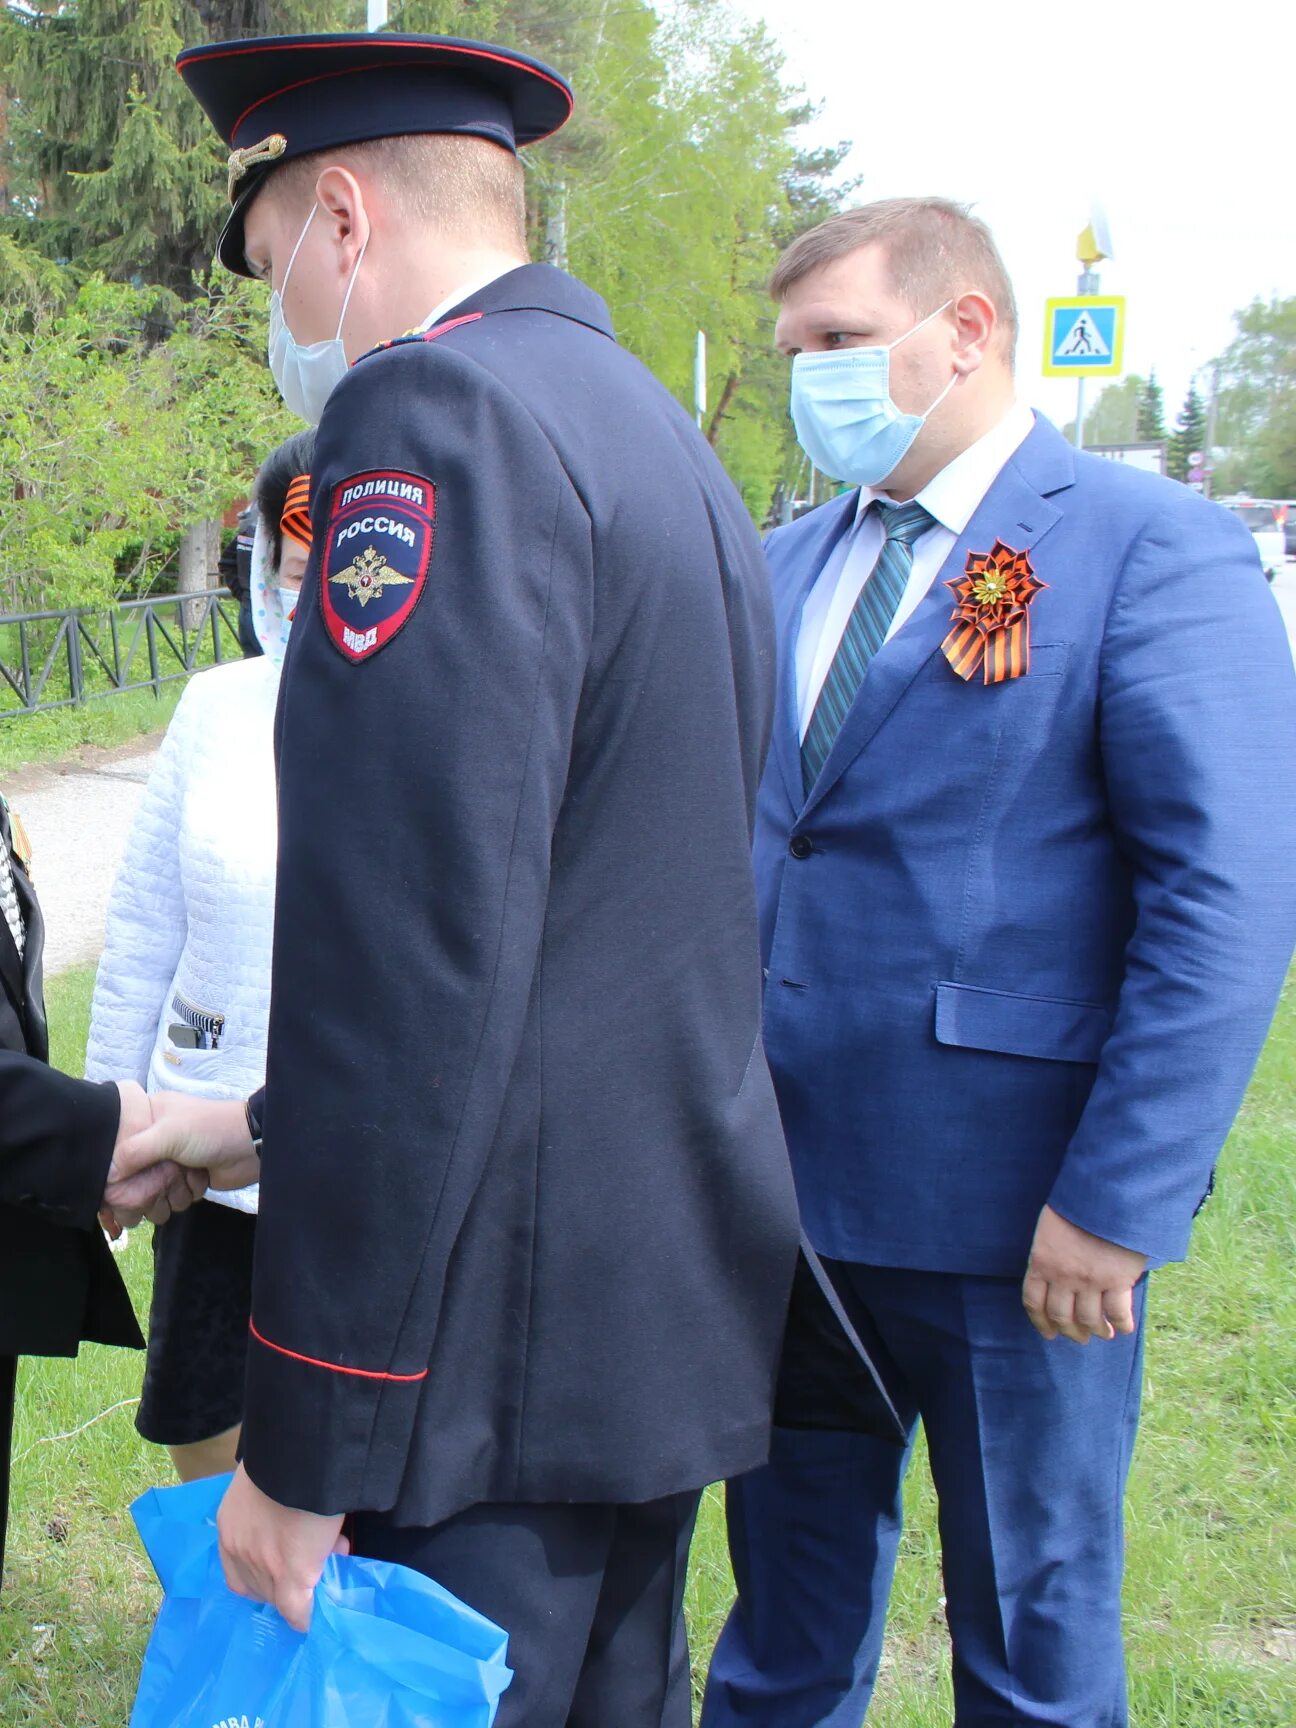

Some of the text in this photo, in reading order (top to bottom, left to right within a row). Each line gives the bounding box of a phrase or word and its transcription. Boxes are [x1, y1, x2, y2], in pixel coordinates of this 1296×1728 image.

[341, 479, 423, 507] ПОЛИЦИЯ
[336, 516, 416, 548] РОССИЯ
[342, 625, 378, 653] МВД
